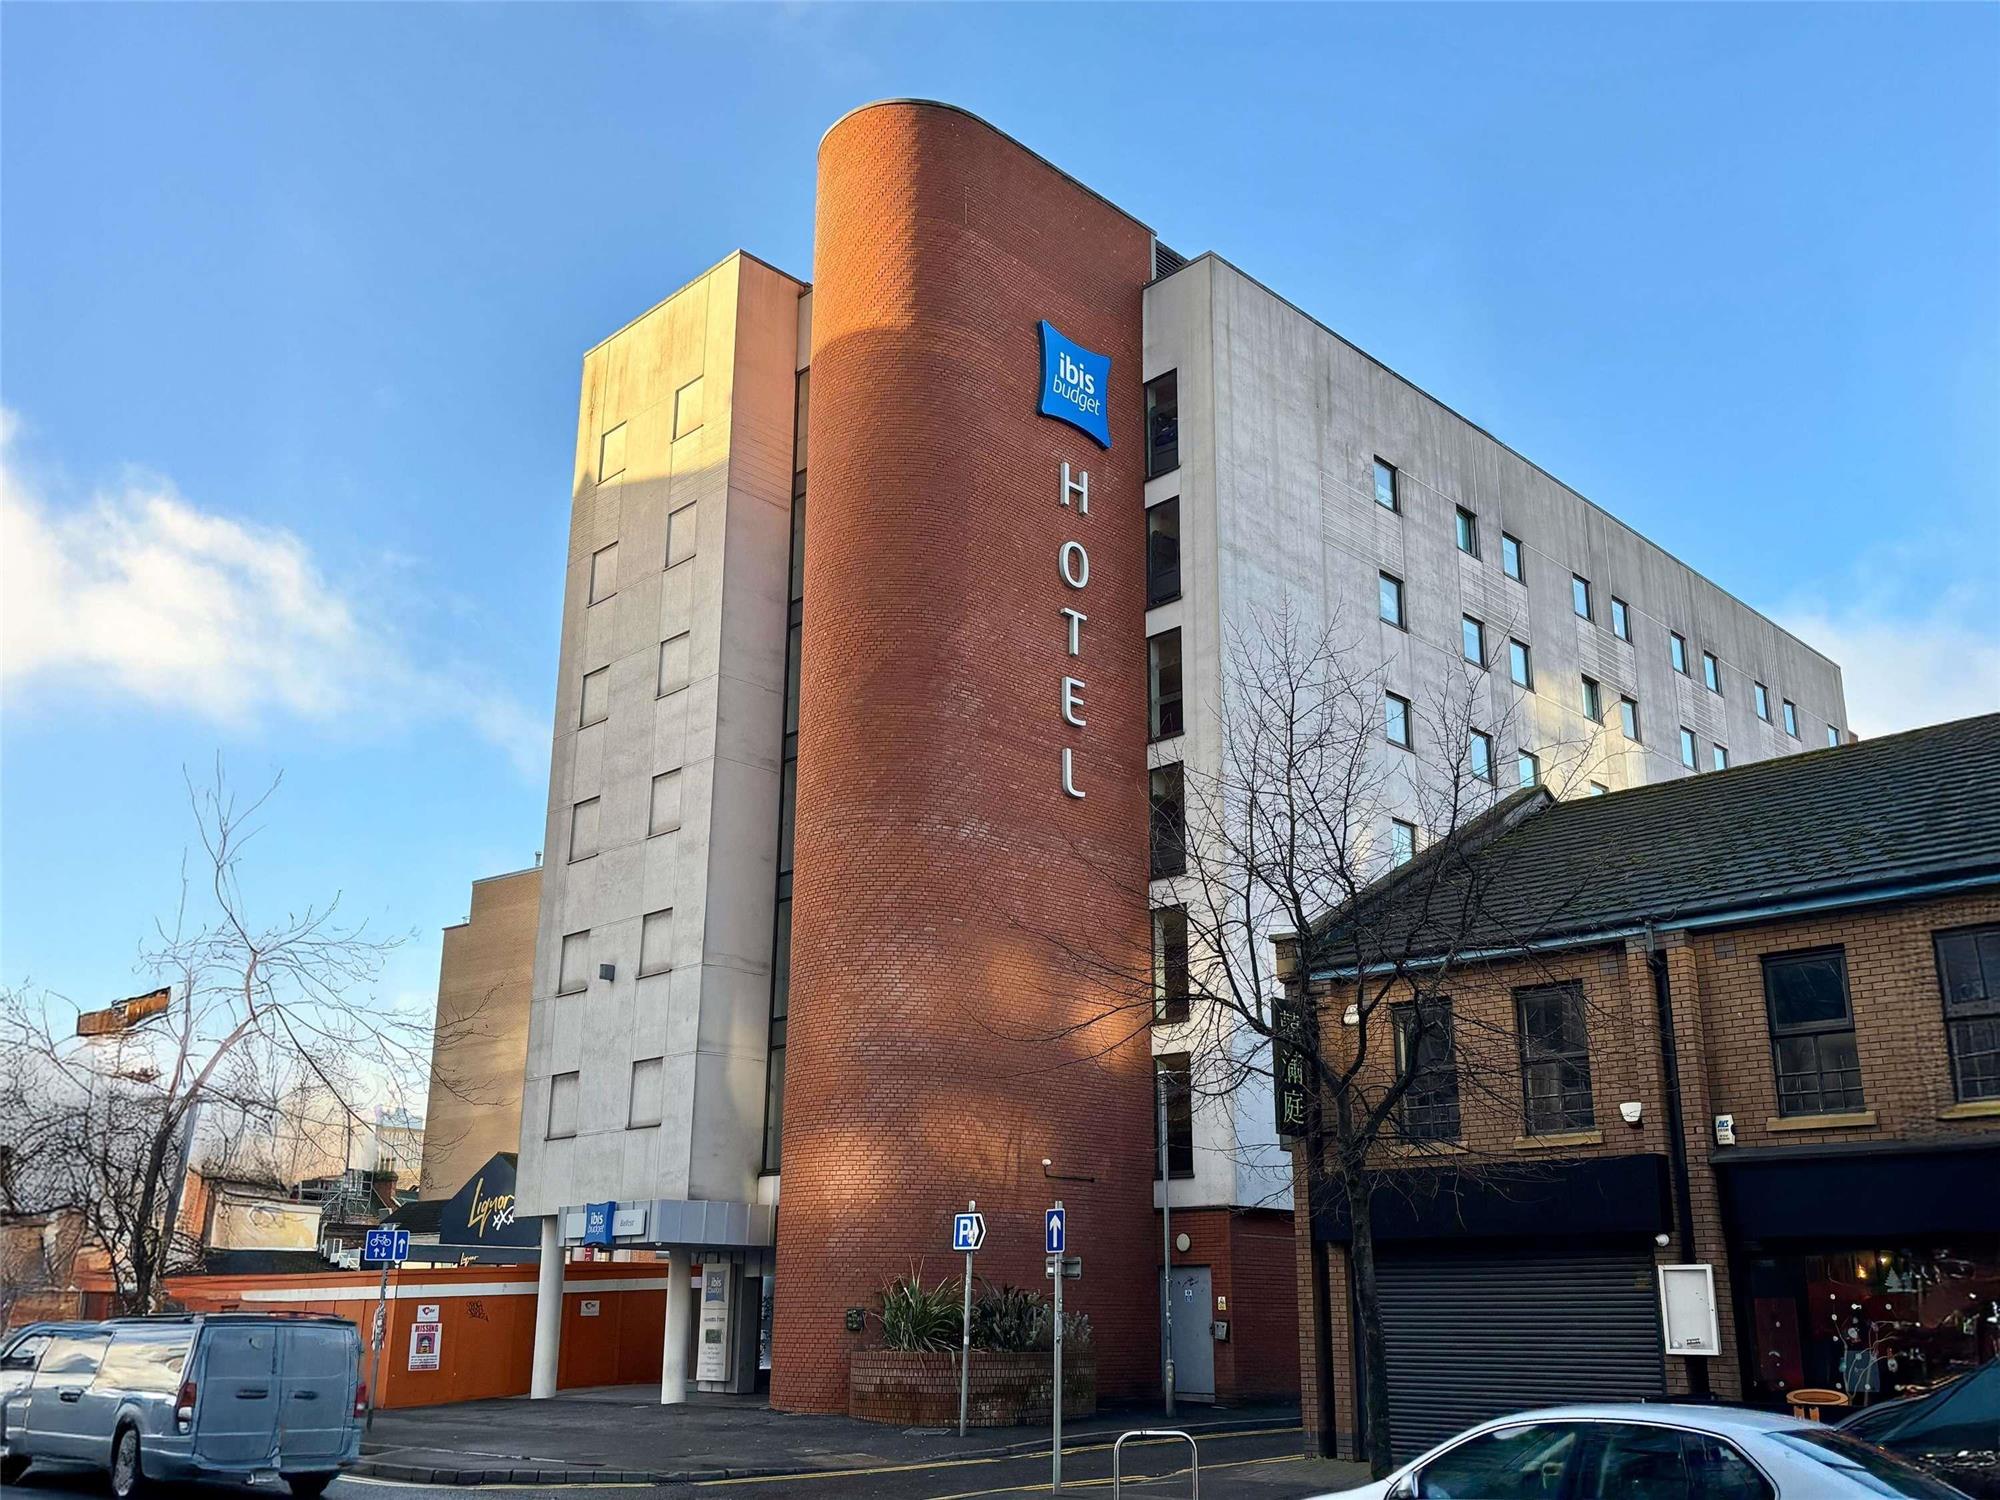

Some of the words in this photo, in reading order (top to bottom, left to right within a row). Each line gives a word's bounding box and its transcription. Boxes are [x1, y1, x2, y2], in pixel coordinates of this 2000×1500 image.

[1060, 351, 1095, 395] ibis
[1053, 374, 1100, 416] budget
[1058, 461, 1089, 799] HOTEL
[590, 1212, 604, 1225] ibis
[958, 1218, 972, 1245] P
